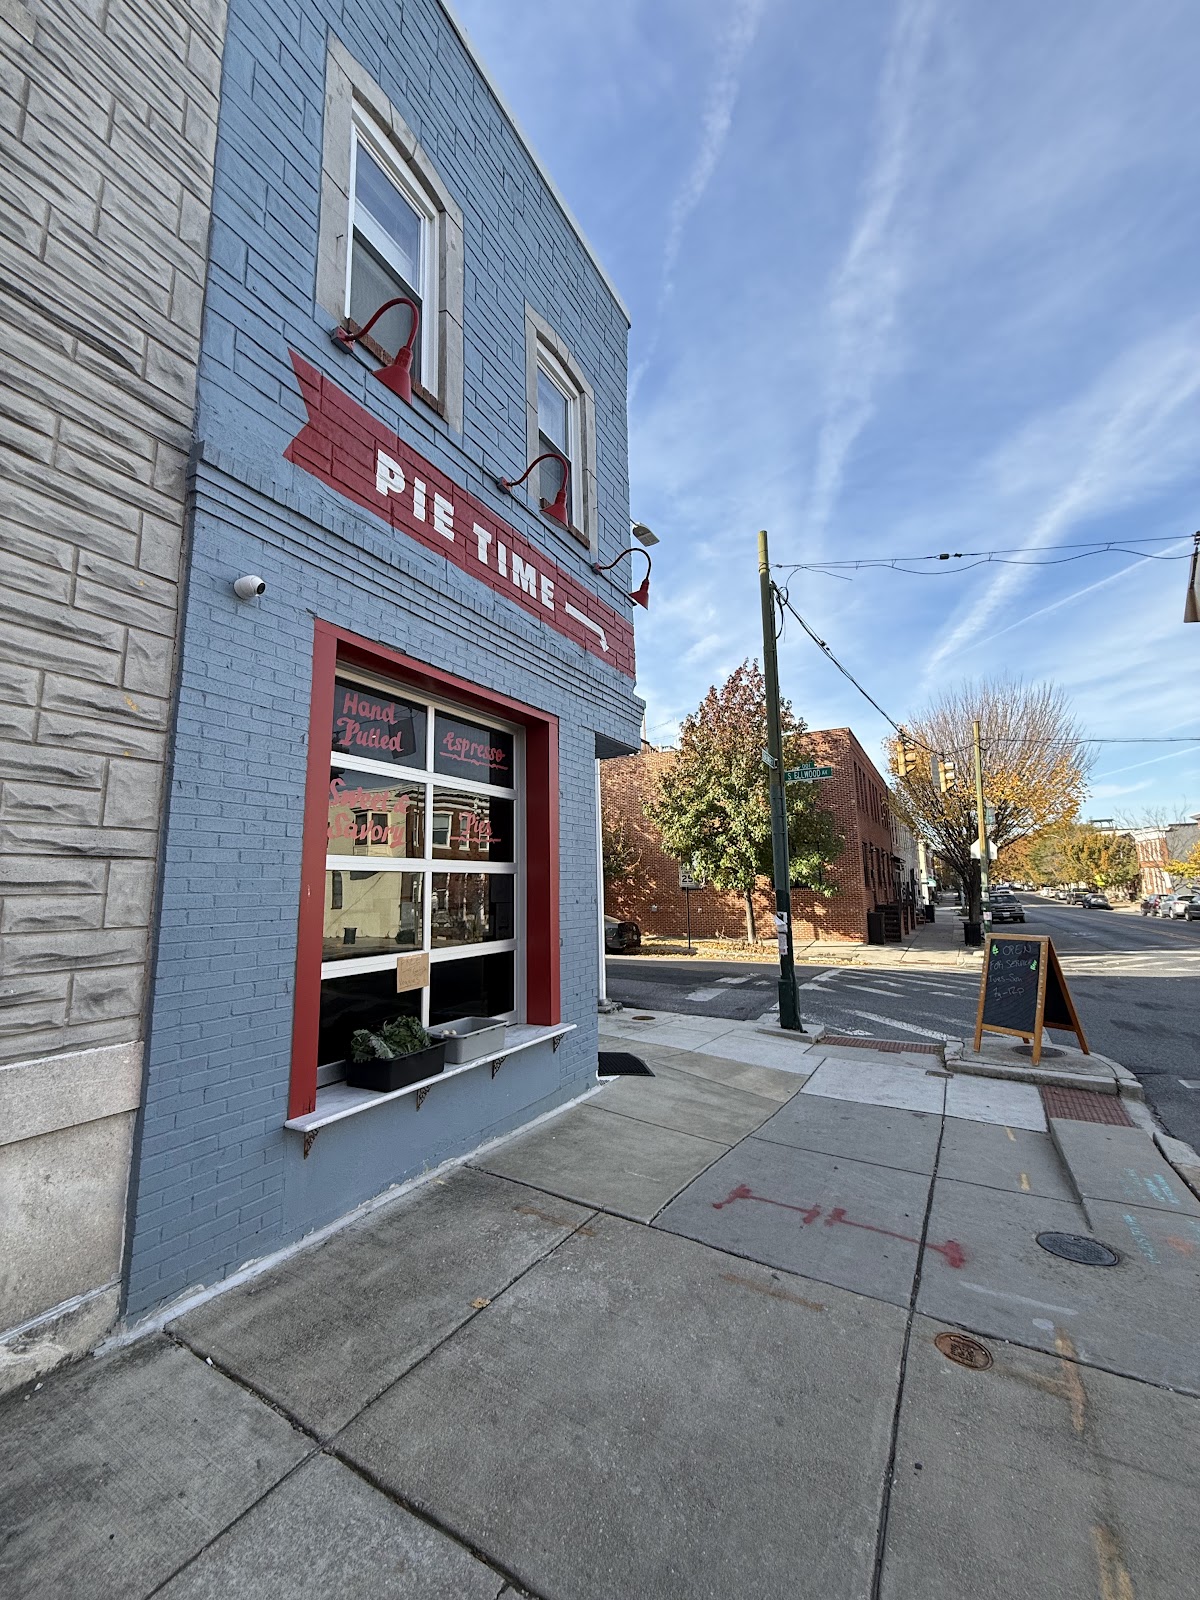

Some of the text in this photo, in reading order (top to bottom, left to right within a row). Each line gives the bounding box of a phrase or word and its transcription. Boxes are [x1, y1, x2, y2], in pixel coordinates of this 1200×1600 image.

[375, 449, 556, 612] PIE TIME
[343, 692, 399, 725] Hand
[337, 716, 404, 752] Pulled
[443, 731, 506, 763] Espresso
[794, 769, 821, 780] ELLWOOD
[329, 777, 390, 811] Sweet
[327, 812, 407, 849] Savory
[459, 811, 493, 836] Pies
[681, 874, 693, 882] 25
[1002, 944, 1032, 956] OPEN
